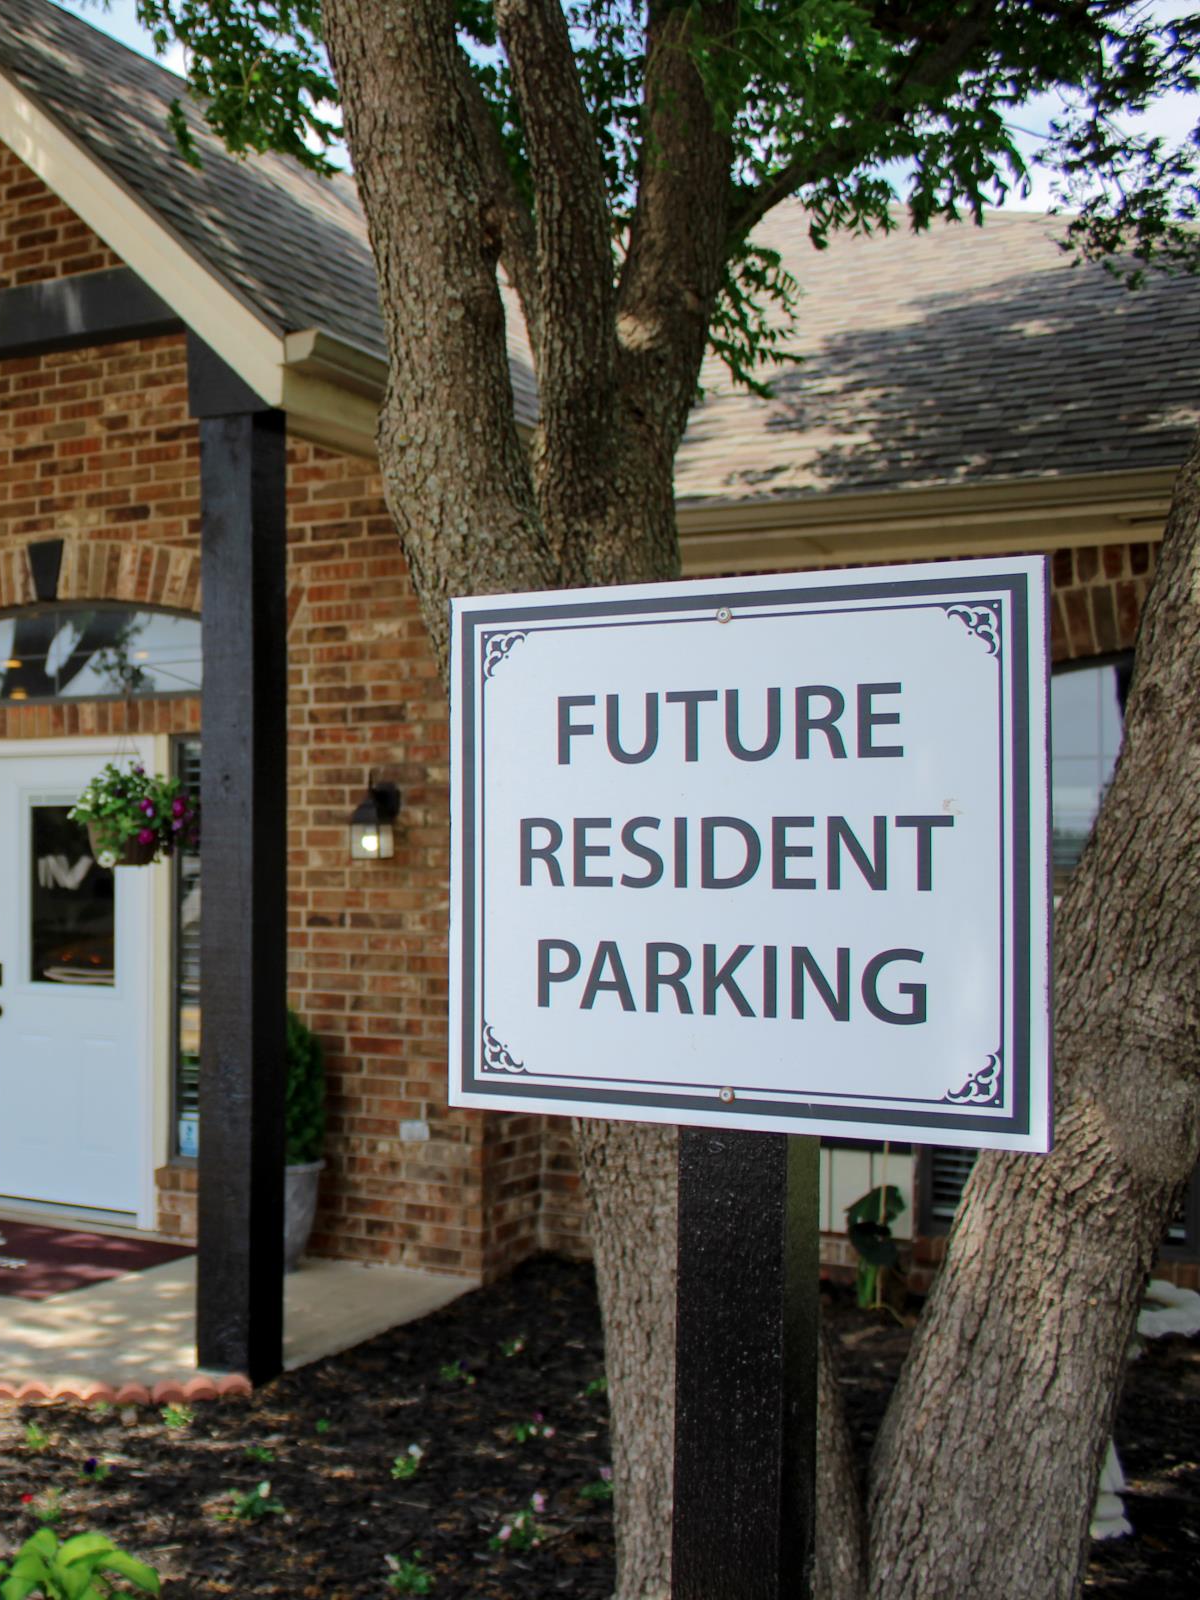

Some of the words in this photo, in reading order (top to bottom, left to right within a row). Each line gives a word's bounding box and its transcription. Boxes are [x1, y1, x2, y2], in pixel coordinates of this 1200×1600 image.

[556, 682, 904, 765] FUTURE
[519, 814, 955, 892] RESIDENT
[536, 938, 928, 1026] PARKING
